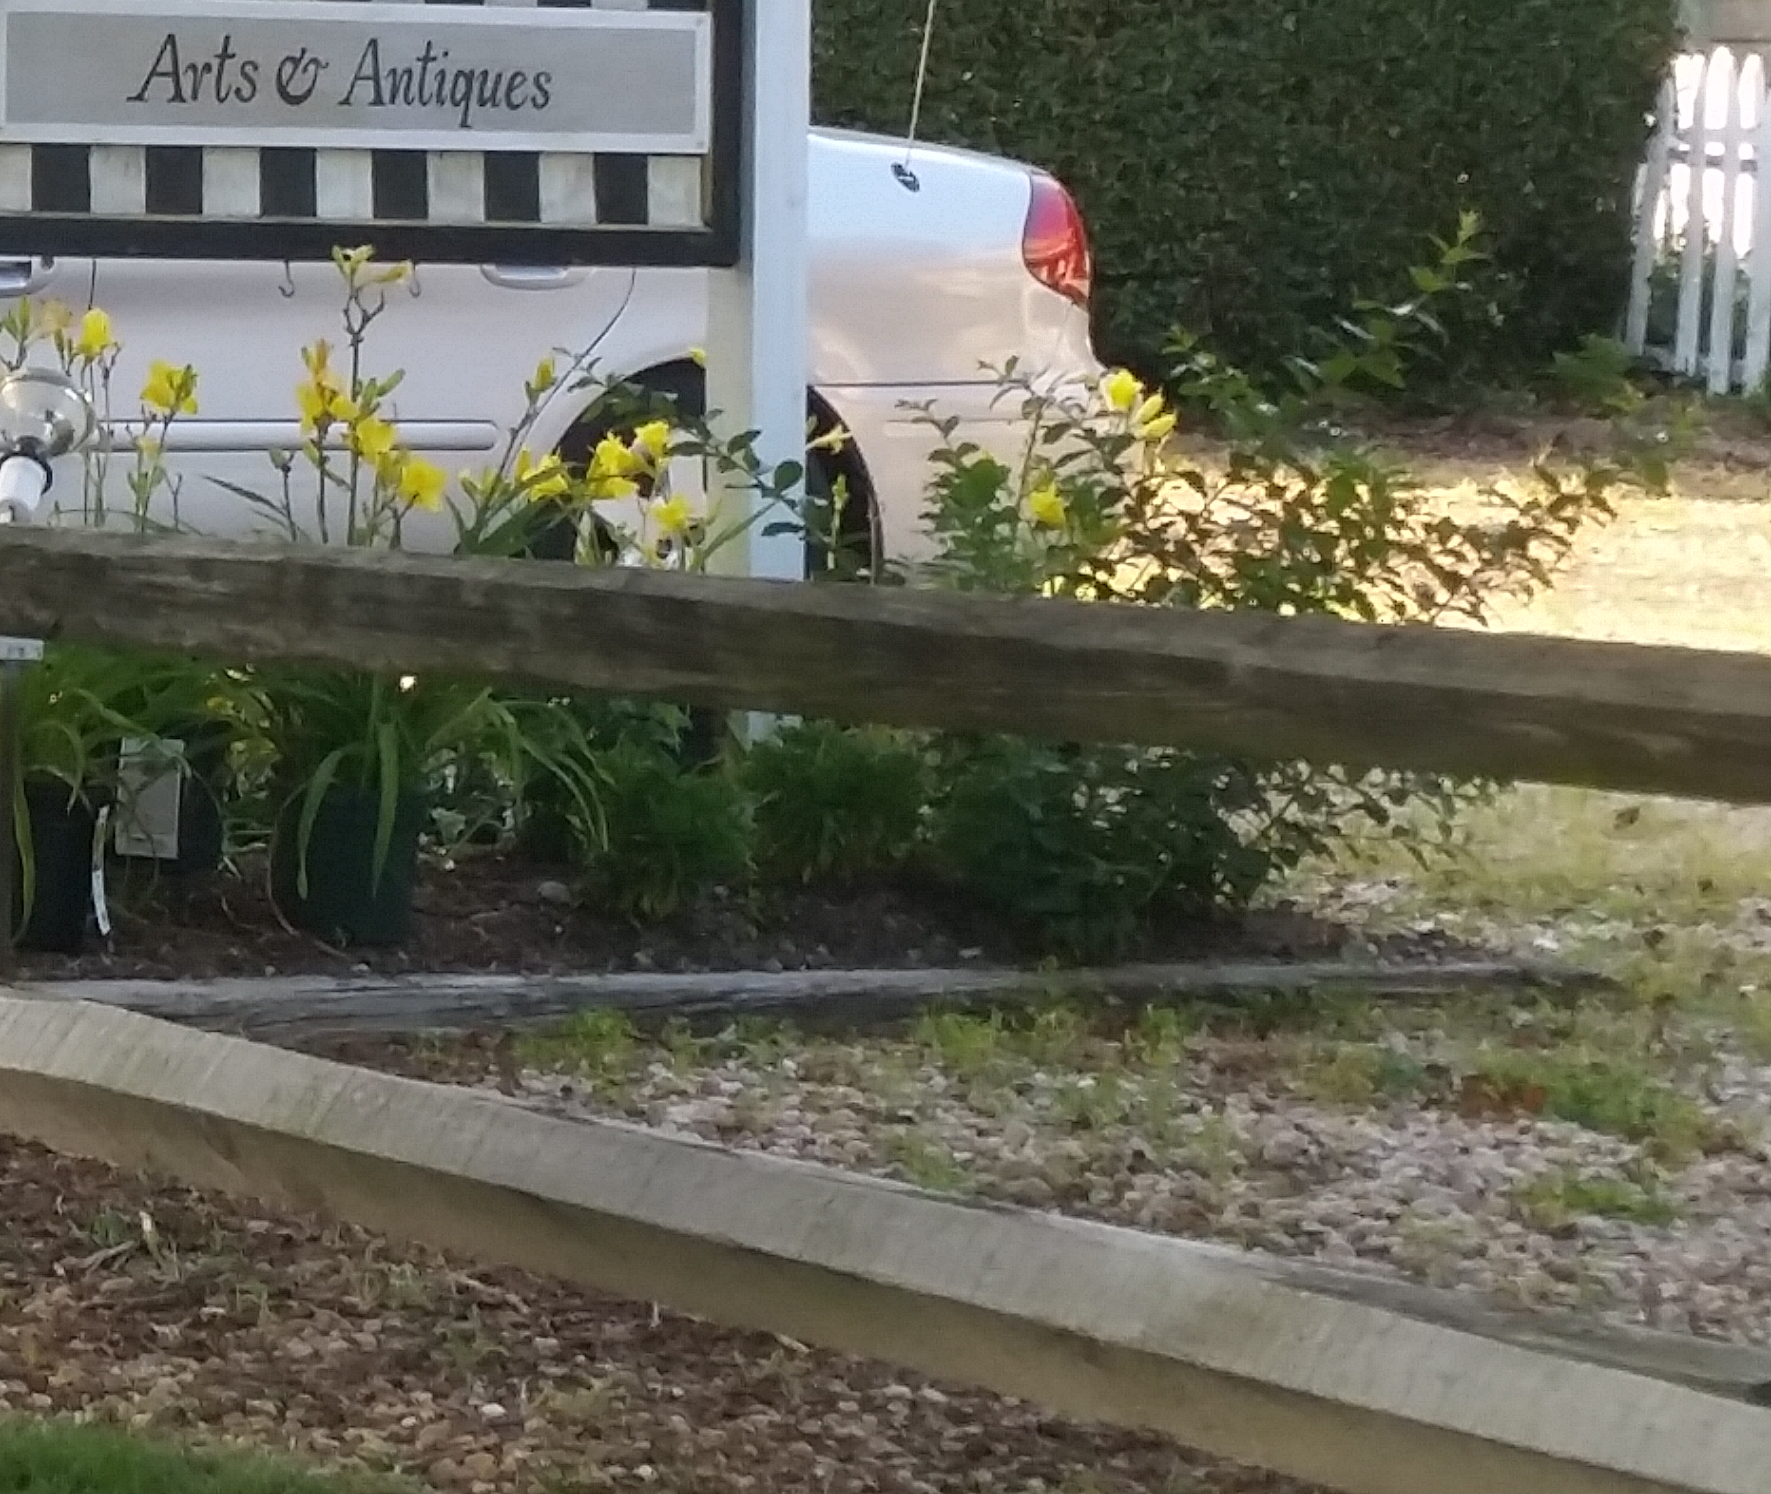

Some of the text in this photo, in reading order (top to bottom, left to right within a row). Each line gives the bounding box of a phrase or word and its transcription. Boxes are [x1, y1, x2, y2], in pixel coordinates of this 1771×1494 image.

[127, 33, 552, 129] Arts & Antiques
